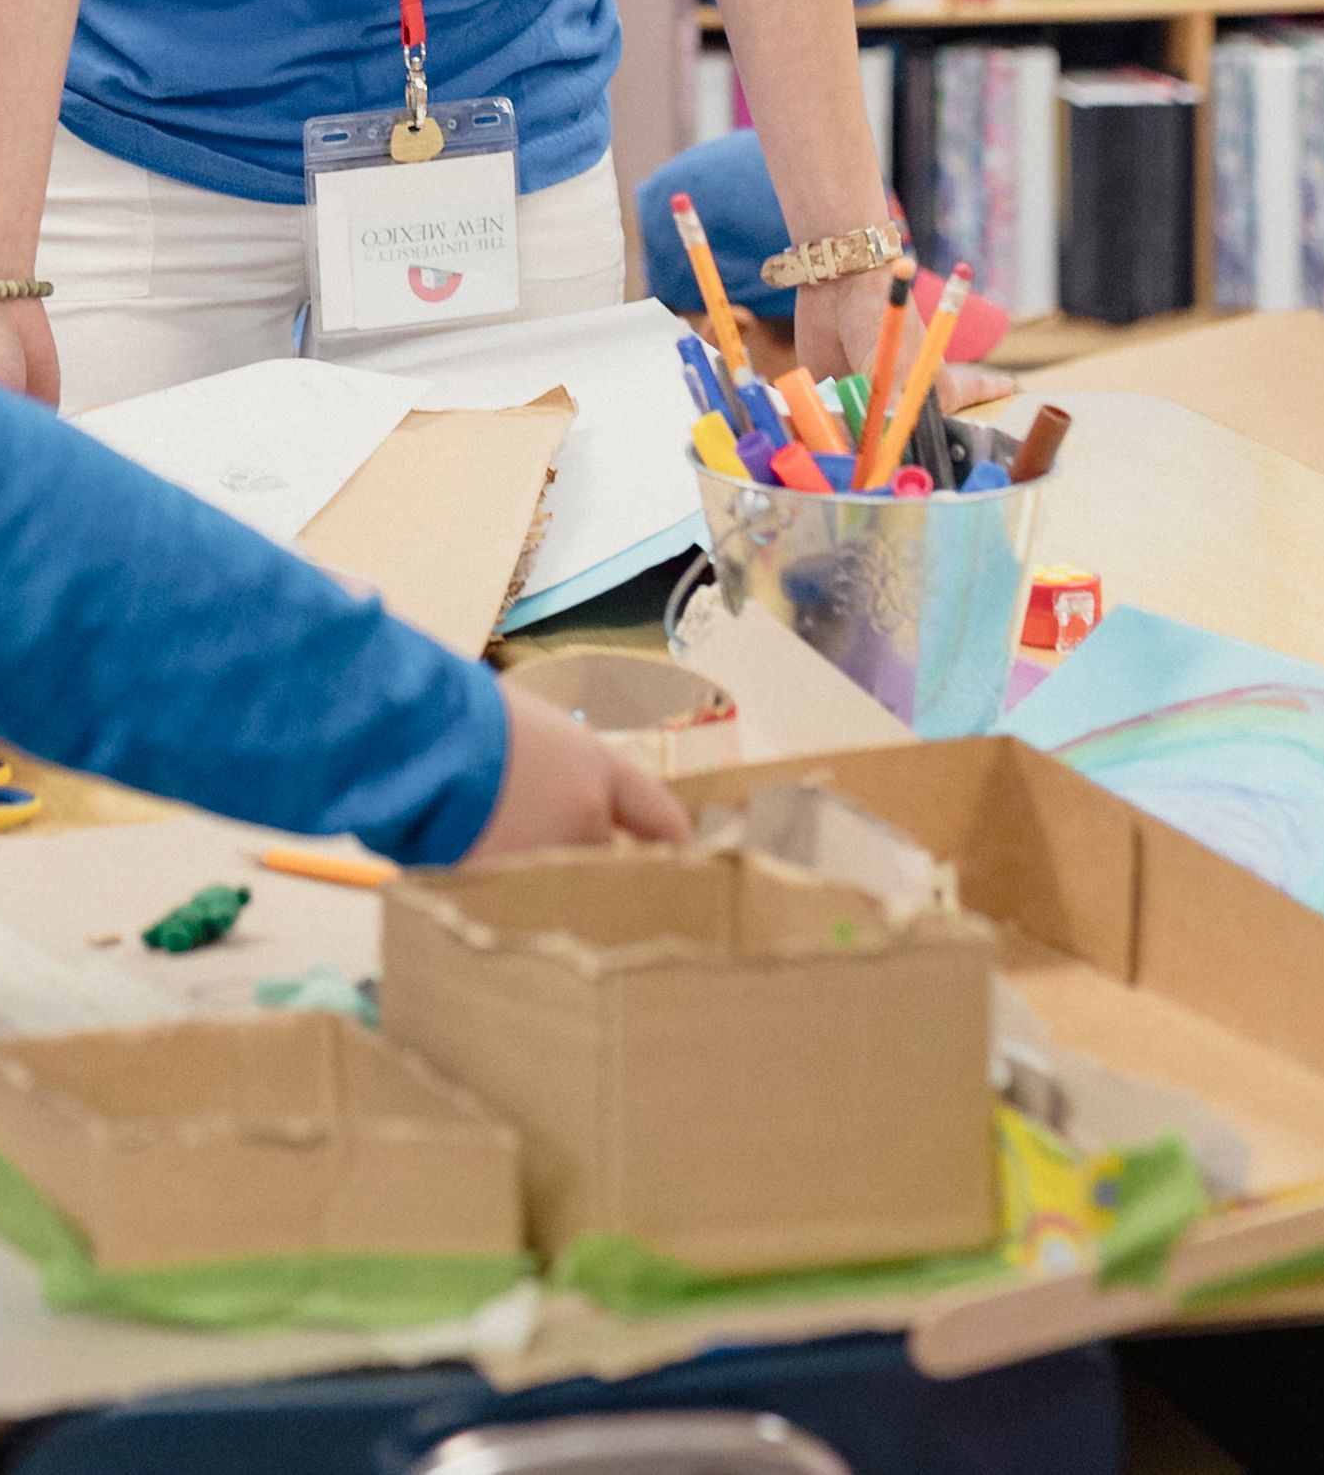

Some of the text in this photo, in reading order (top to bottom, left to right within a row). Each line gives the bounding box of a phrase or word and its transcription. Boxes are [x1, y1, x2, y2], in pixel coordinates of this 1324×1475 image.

[361, 215, 504, 248] NEW MEXICO
[377, 240, 469, 262] UNIVERSITY
[476, 237, 506, 254] THE
